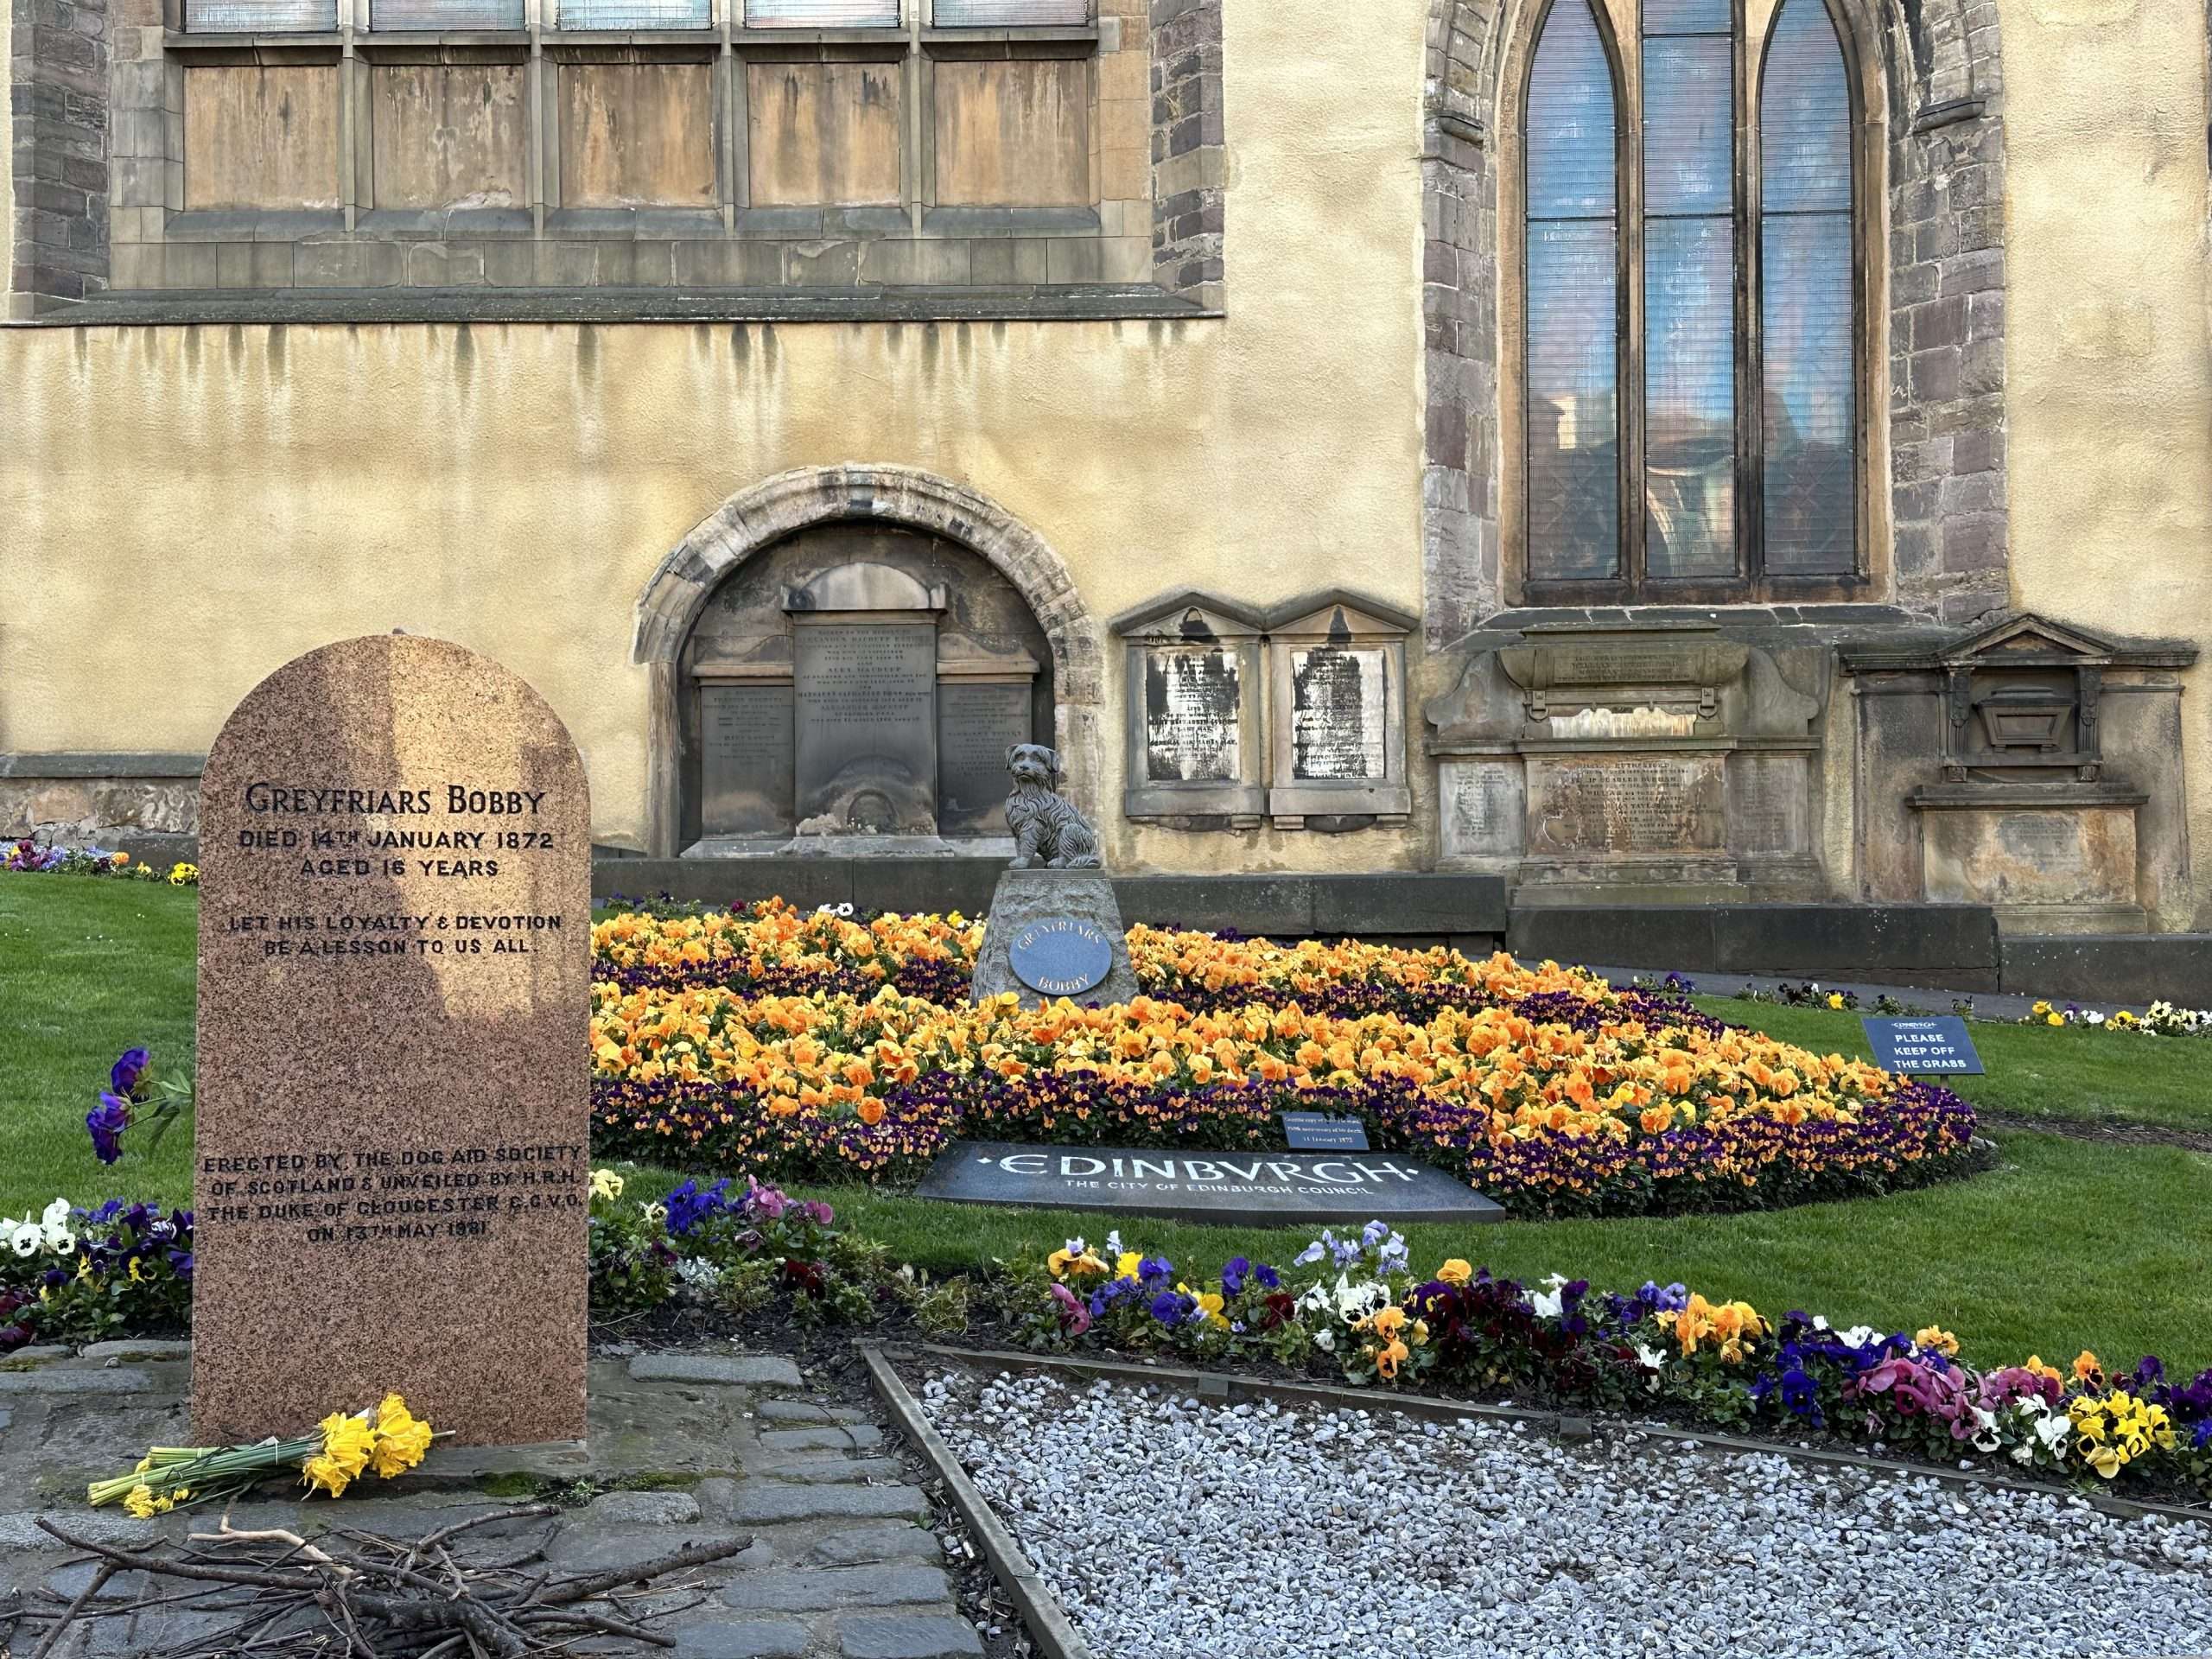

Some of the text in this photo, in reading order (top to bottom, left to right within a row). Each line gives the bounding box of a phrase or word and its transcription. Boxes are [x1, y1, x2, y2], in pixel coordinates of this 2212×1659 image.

[245, 782, 546, 815] GREYFRIARS BOBBY
[239, 830, 554, 849] DIED 14TH JANUARY 1872
[301, 860, 499, 877] AGED 16 YEARS
[229, 915, 562, 931] LET HIS LOYALTY & DEVOTION
[264, 940, 293, 955] BE
[299, 941, 317, 955] A
[321, 939, 409, 955] LESSON
[416, 939, 442, 954] TO
[455, 939, 481, 954] US
[1038, 973, 1090, 993] BOBBY
[1894, 1033, 1946, 1043] PLEASE
[1893, 1046, 1955, 1056] KEEP OFF
[1893, 1059, 1967, 1069] THE GRASS
[204, 1145, 582, 1173] ERECTED BY THE DOG AID SOCIETY
[998, 1153, 1410, 1184] EDINBVRGH
[211, 1182, 236, 1197] OF
[248, 1177, 356, 1195] SCOTLAND
[362, 1176, 372, 1190] &
[380, 1173, 480, 1191] UNVEILED
[490, 1172, 514, 1185] BY
[1065, 1179, 1100, 1189] THE
[1107, 1181, 1148, 1190] CITY
[1186, 1185, 1293, 1194] EDINBURGH
[1298, 1186, 1375, 1195] COUNCIL
[209, 1205, 249, 1221] THE
[261, 1204, 319, 1219] DUKE
[323, 1202, 348, 1217] OF
[357, 1198, 499, 1217] GLOUCESTER
[307, 1228, 334, 1243] ON
[397, 1224, 444, 1239] MAY
[448, 1219, 487, 1236] 1981
